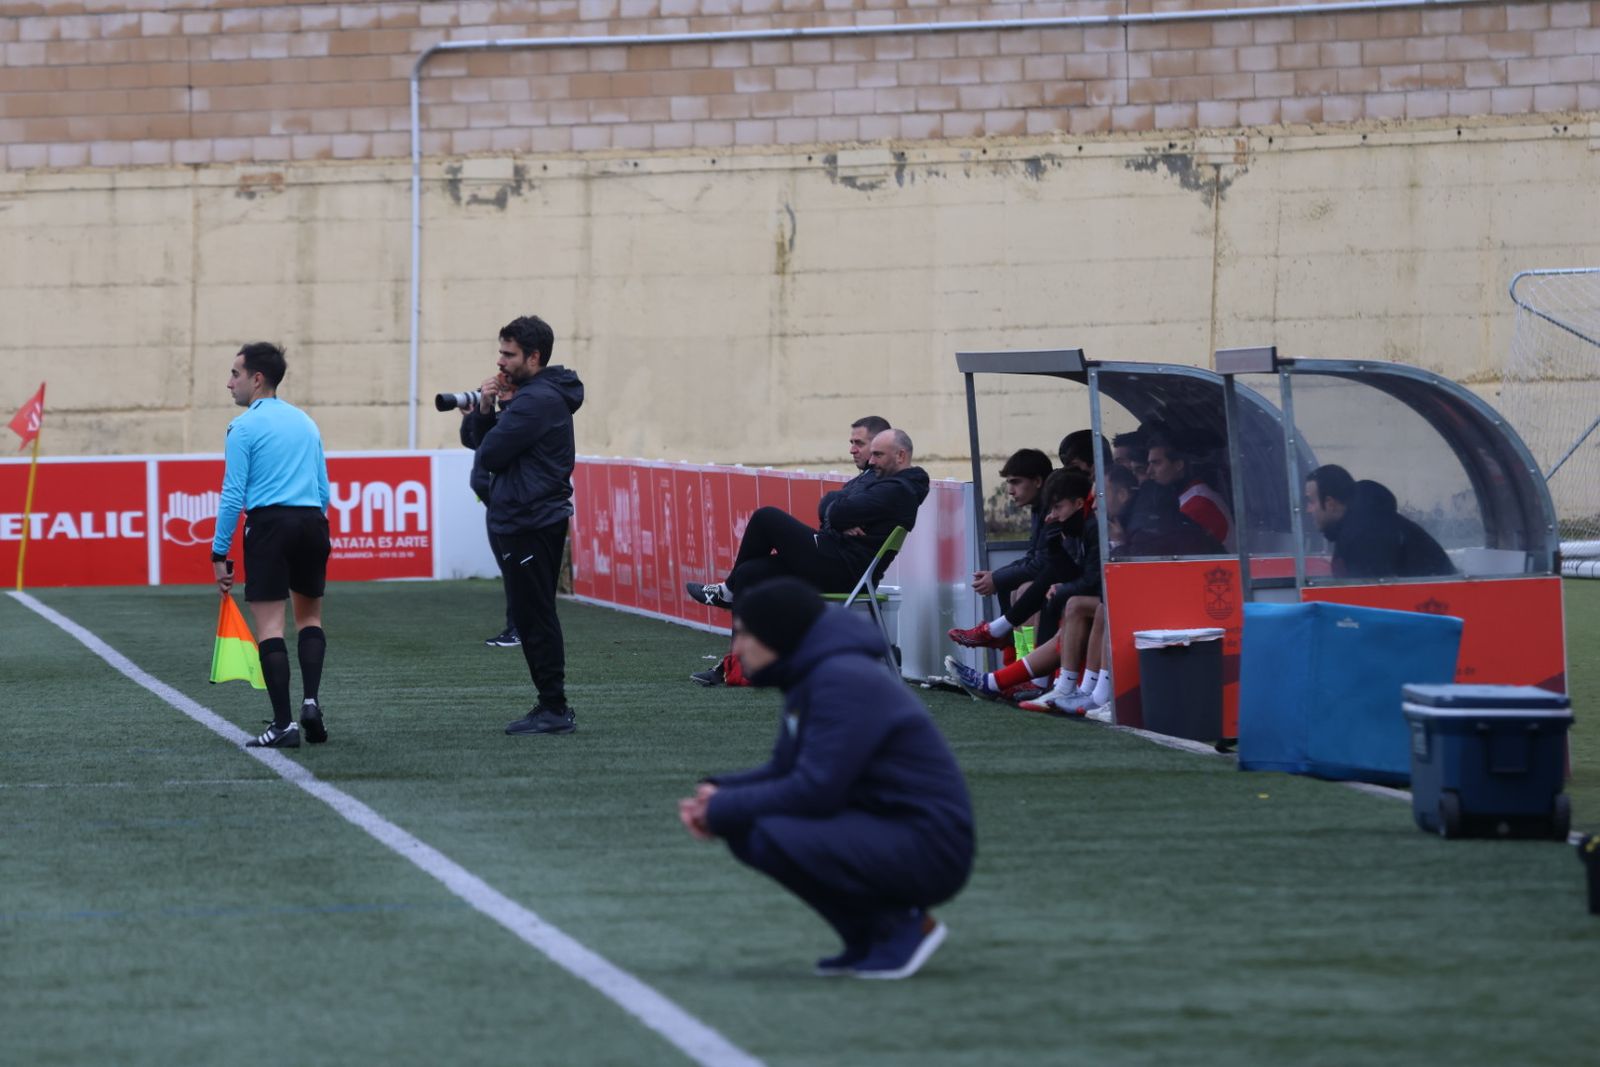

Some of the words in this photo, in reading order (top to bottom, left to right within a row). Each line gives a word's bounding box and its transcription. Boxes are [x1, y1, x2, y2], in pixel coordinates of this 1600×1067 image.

[329, 537, 375, 548] ATATA
[378, 537, 393, 548] ES
[395, 536, 429, 548] ARTE
